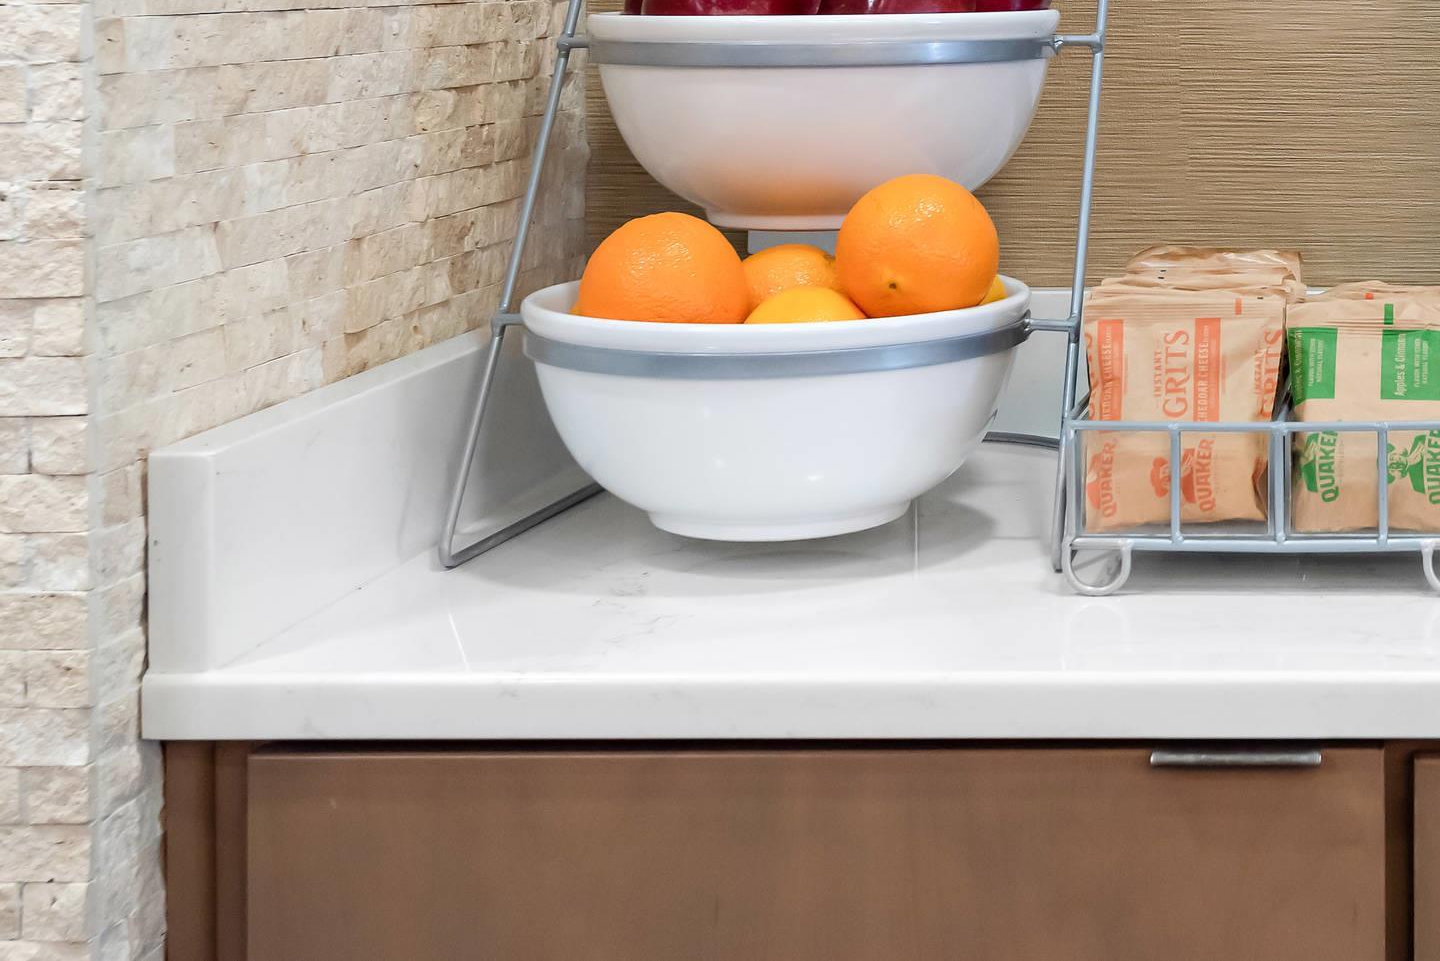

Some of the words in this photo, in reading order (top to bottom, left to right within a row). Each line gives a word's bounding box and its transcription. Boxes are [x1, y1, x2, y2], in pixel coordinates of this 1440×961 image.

[1153, 350, 1162, 398] INSTANT
[1162, 330, 1190, 418] GRITS
[1198, 342, 1209, 378] CHEESE
[1394, 372, 1408, 396] Apples
[1102, 381, 1113, 422] HEDDAR
[1099, 442, 1117, 518] QUAKER
[1196, 439, 1216, 512] QUAKER
